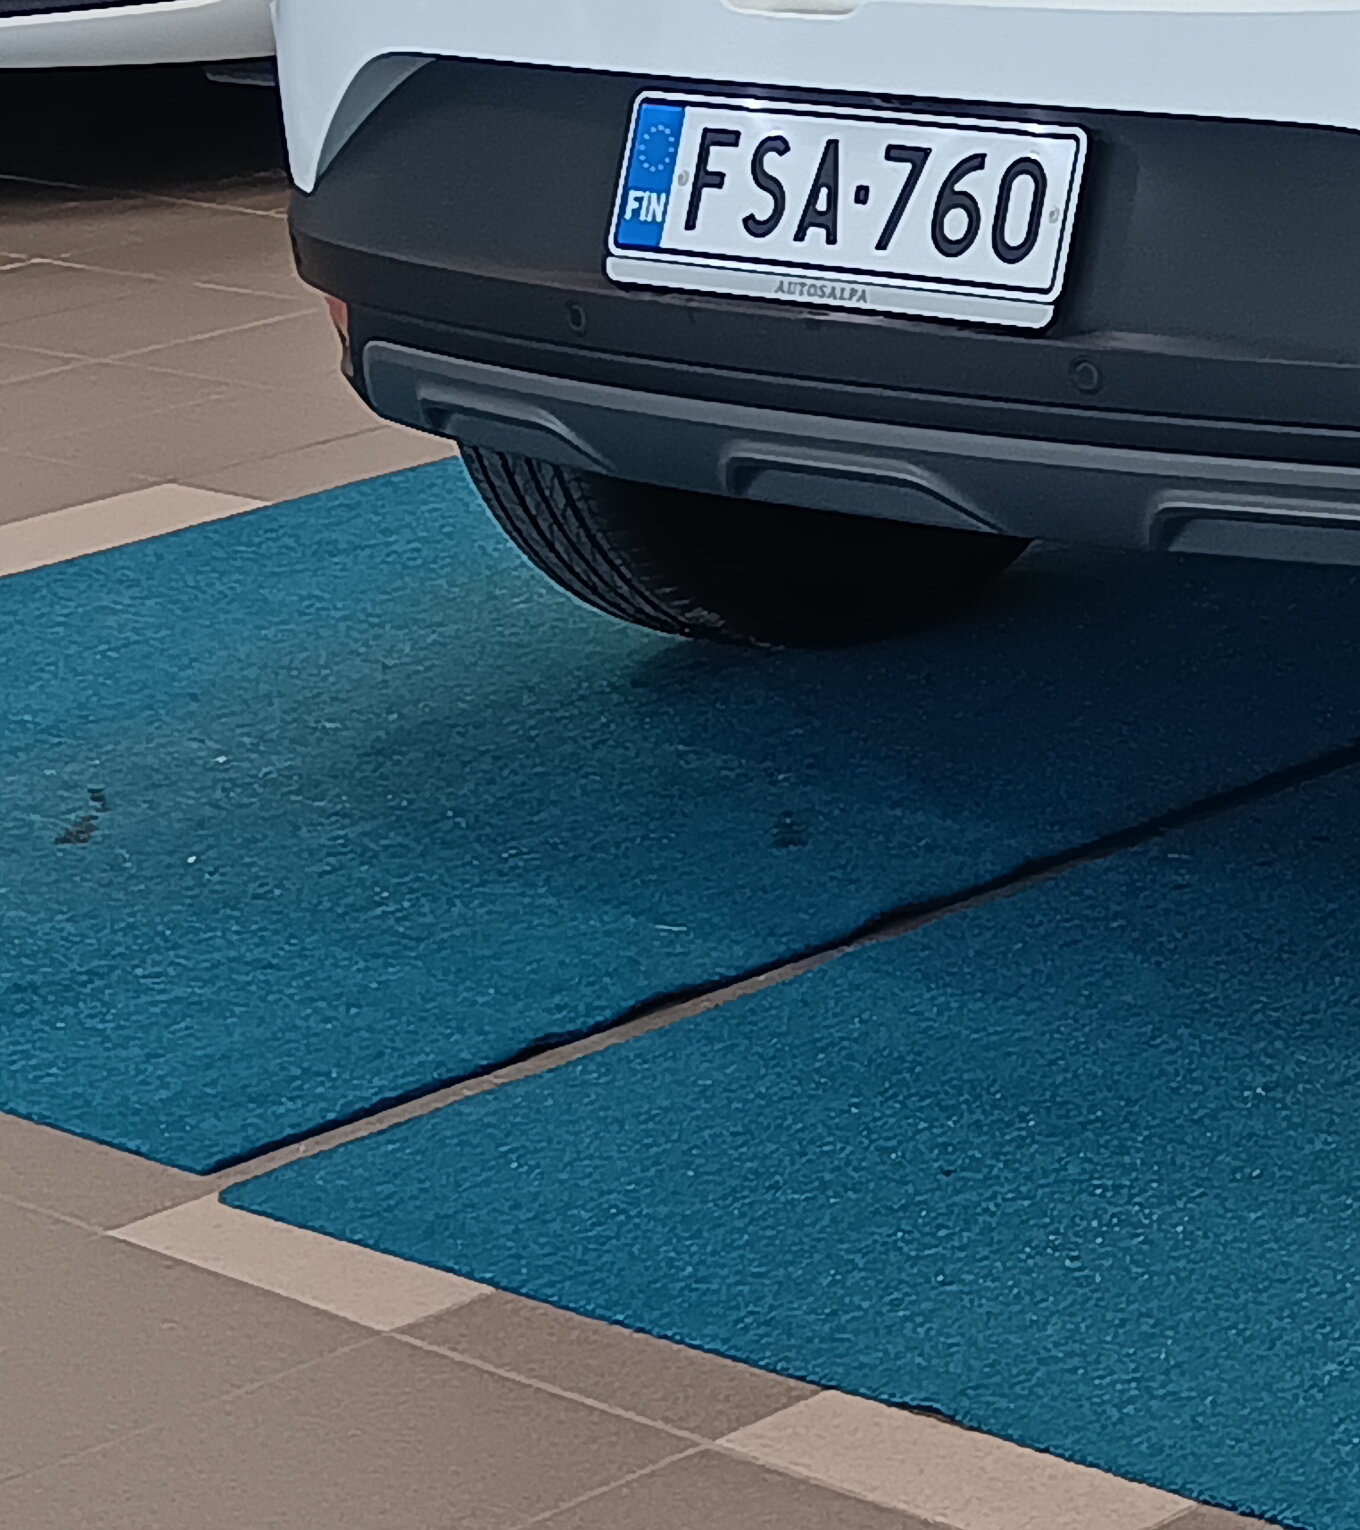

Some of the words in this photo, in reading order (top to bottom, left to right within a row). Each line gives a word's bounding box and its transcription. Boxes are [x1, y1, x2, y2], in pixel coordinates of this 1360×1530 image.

[623, 189, 667, 223] FIN
[684, 126, 1048, 265] FSA-760
[773, 277, 869, 304] AUTOSALPA
